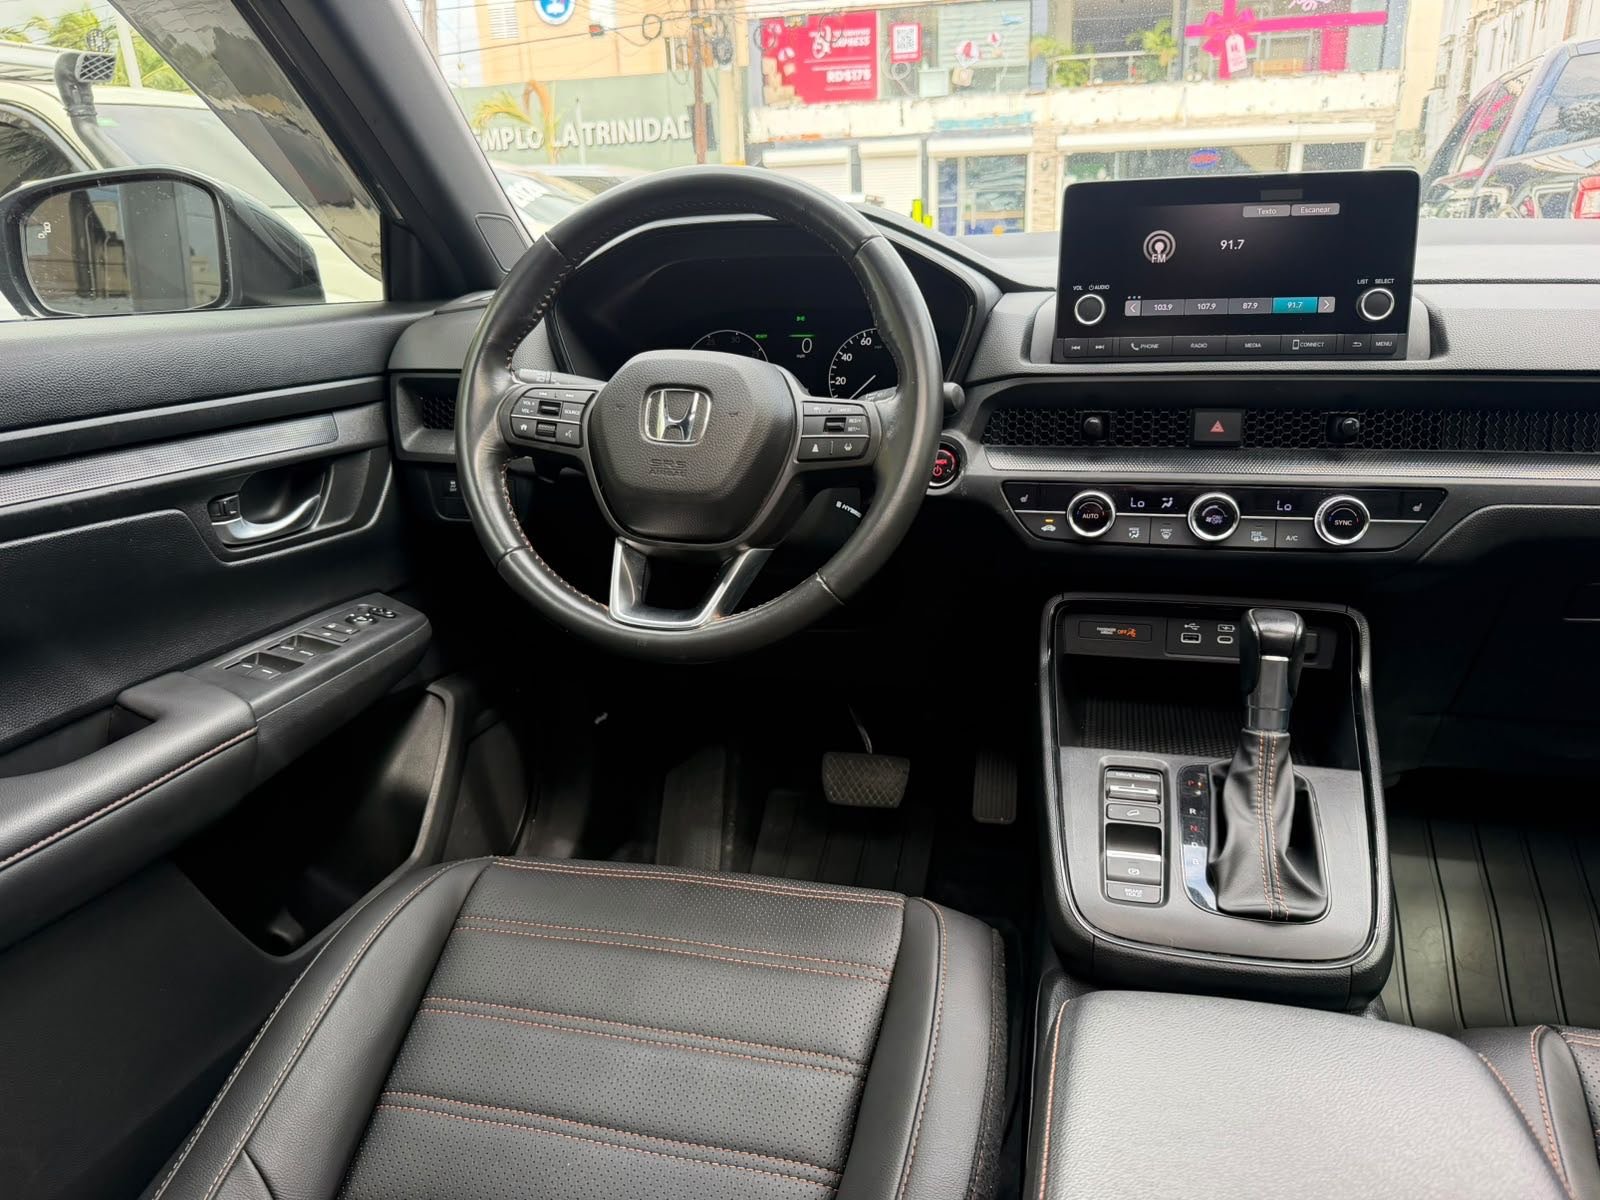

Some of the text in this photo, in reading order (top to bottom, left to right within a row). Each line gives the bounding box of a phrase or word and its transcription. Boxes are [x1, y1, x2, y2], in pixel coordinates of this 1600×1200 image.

[1256, 207, 1277, 215] Texto
[1300, 206, 1331, 214] Escanear
[1220, 239, 1245, 250] 91.7
[1151, 253, 1167, 263] FM
[1287, 301, 1303, 309] 91.7
[860, 337, 872, 346] 60
[841, 353, 852, 361] 40
[835, 377, 846, 385] 20
